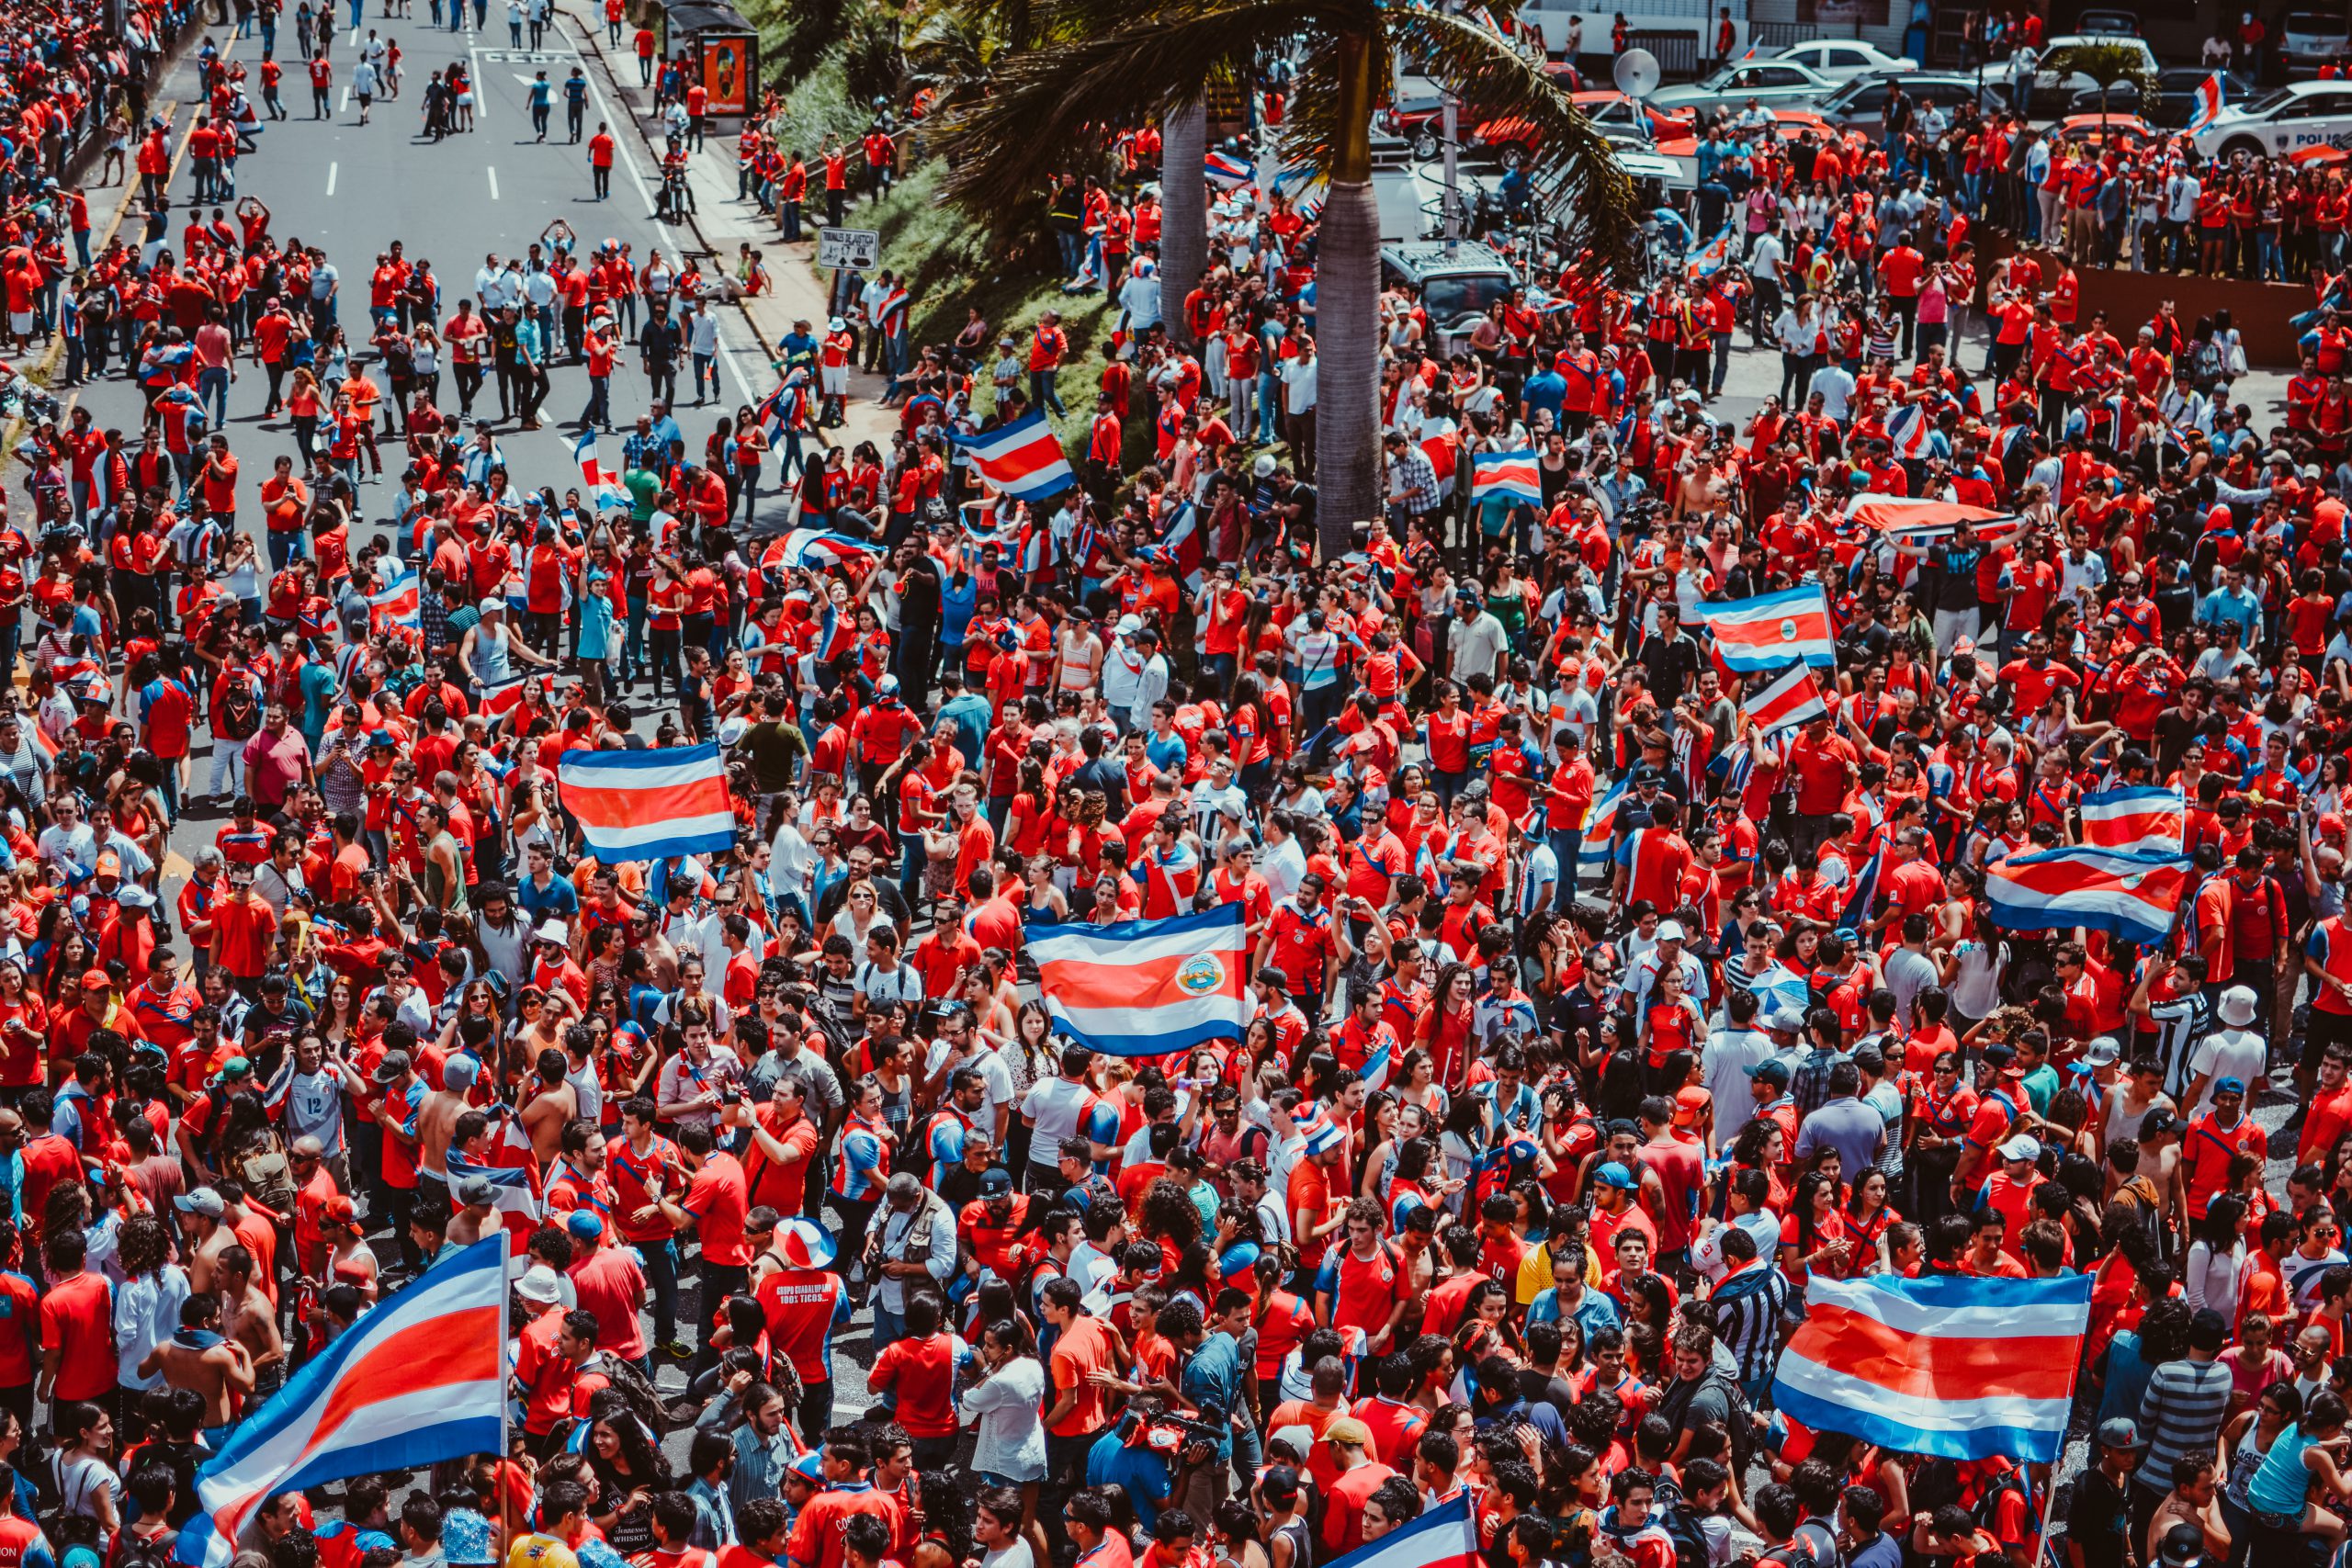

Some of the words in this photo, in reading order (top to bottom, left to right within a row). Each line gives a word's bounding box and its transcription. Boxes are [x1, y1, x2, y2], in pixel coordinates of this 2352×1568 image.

[485, 53, 571, 64] CEDA
[307, 1098, 322, 1114] 12
[1493, 1262, 1505, 1280] 10
[776, 1286, 794, 1295] GRUPO
[795, 1284, 831, 1294] GUADALUPANO
[613, 1534, 649, 1543] WHISKEY
